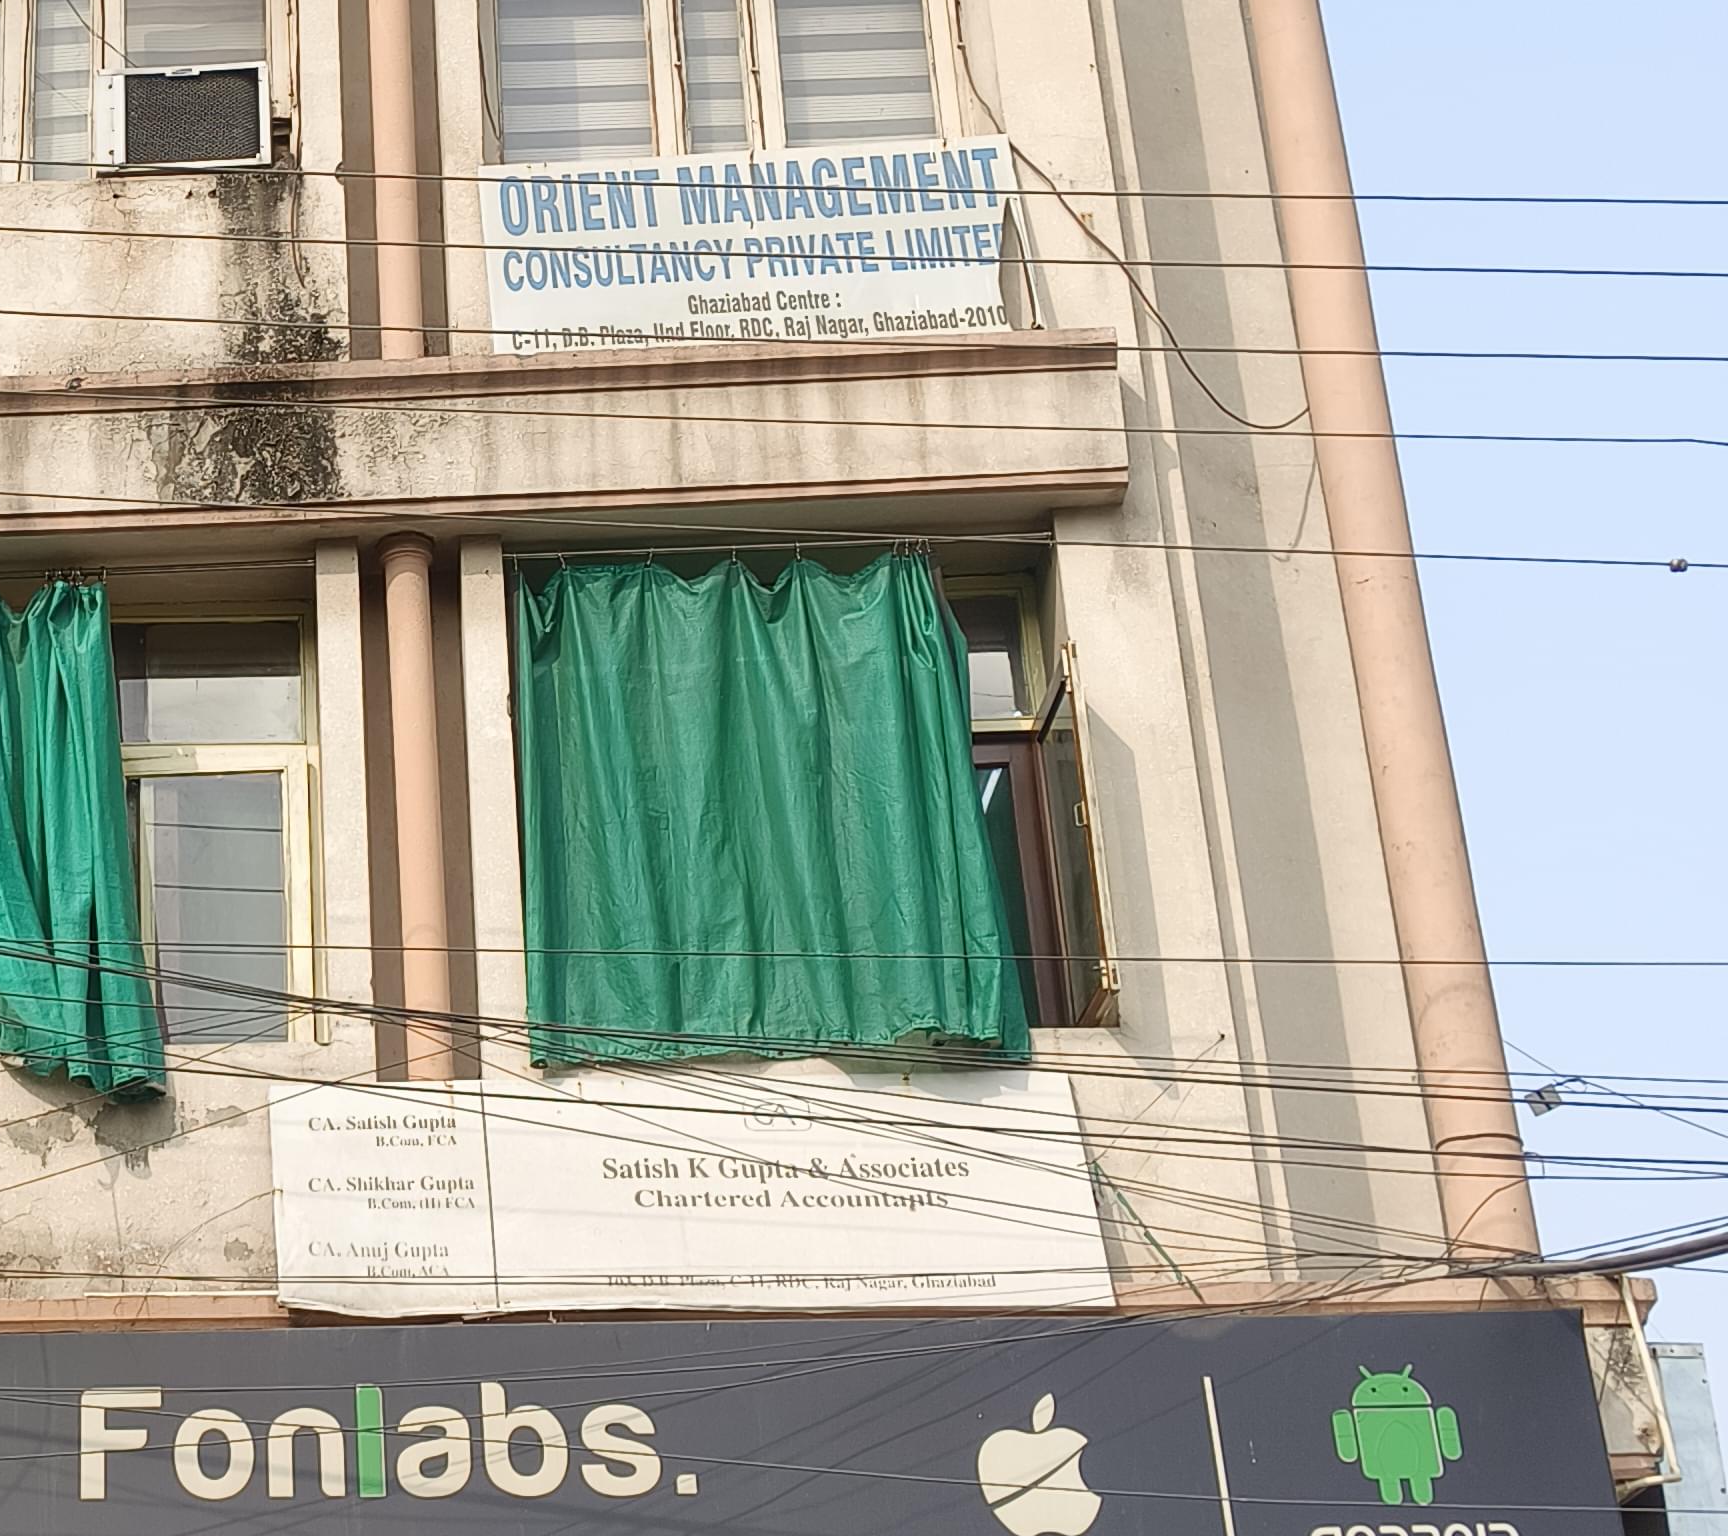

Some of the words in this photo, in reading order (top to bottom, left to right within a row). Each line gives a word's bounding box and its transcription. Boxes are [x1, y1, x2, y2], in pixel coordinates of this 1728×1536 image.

[500, 169, 659, 236] ORIENT
[678, 147, 1000, 226] MANAGEMENT
[503, 238, 732, 292] CONSULTANCY
[745, 231, 879, 280] PRIVATE
[688, 292, 770, 315] Ghaziabad
[777, 290, 829, 311] Centre
[784, 317, 810, 340] Raj
[816, 314, 869, 337] Nagar,
[345, 1115, 397, 1131] Satish
[403, 1115, 457, 1132] Gupta
[603, 1157, 679, 1180] Satish
[689, 1158, 709, 1179] K
[718, 1157, 800, 1184] Gupta
[808, 1157, 830, 1179] &
[838, 1157, 970, 1179] Associates
[346, 1176, 415, 1192] Shikhar
[420, 1176, 475, 1194] Gupta
[634, 1189, 772, 1208] Chartered
[780, 1189, 949, 1210] Accountants
[346, 1242, 389, 1261] Anuj
[394, 1241, 449, 1262] Gupta
[78, 1381, 699, 1501] Fonlabs.
